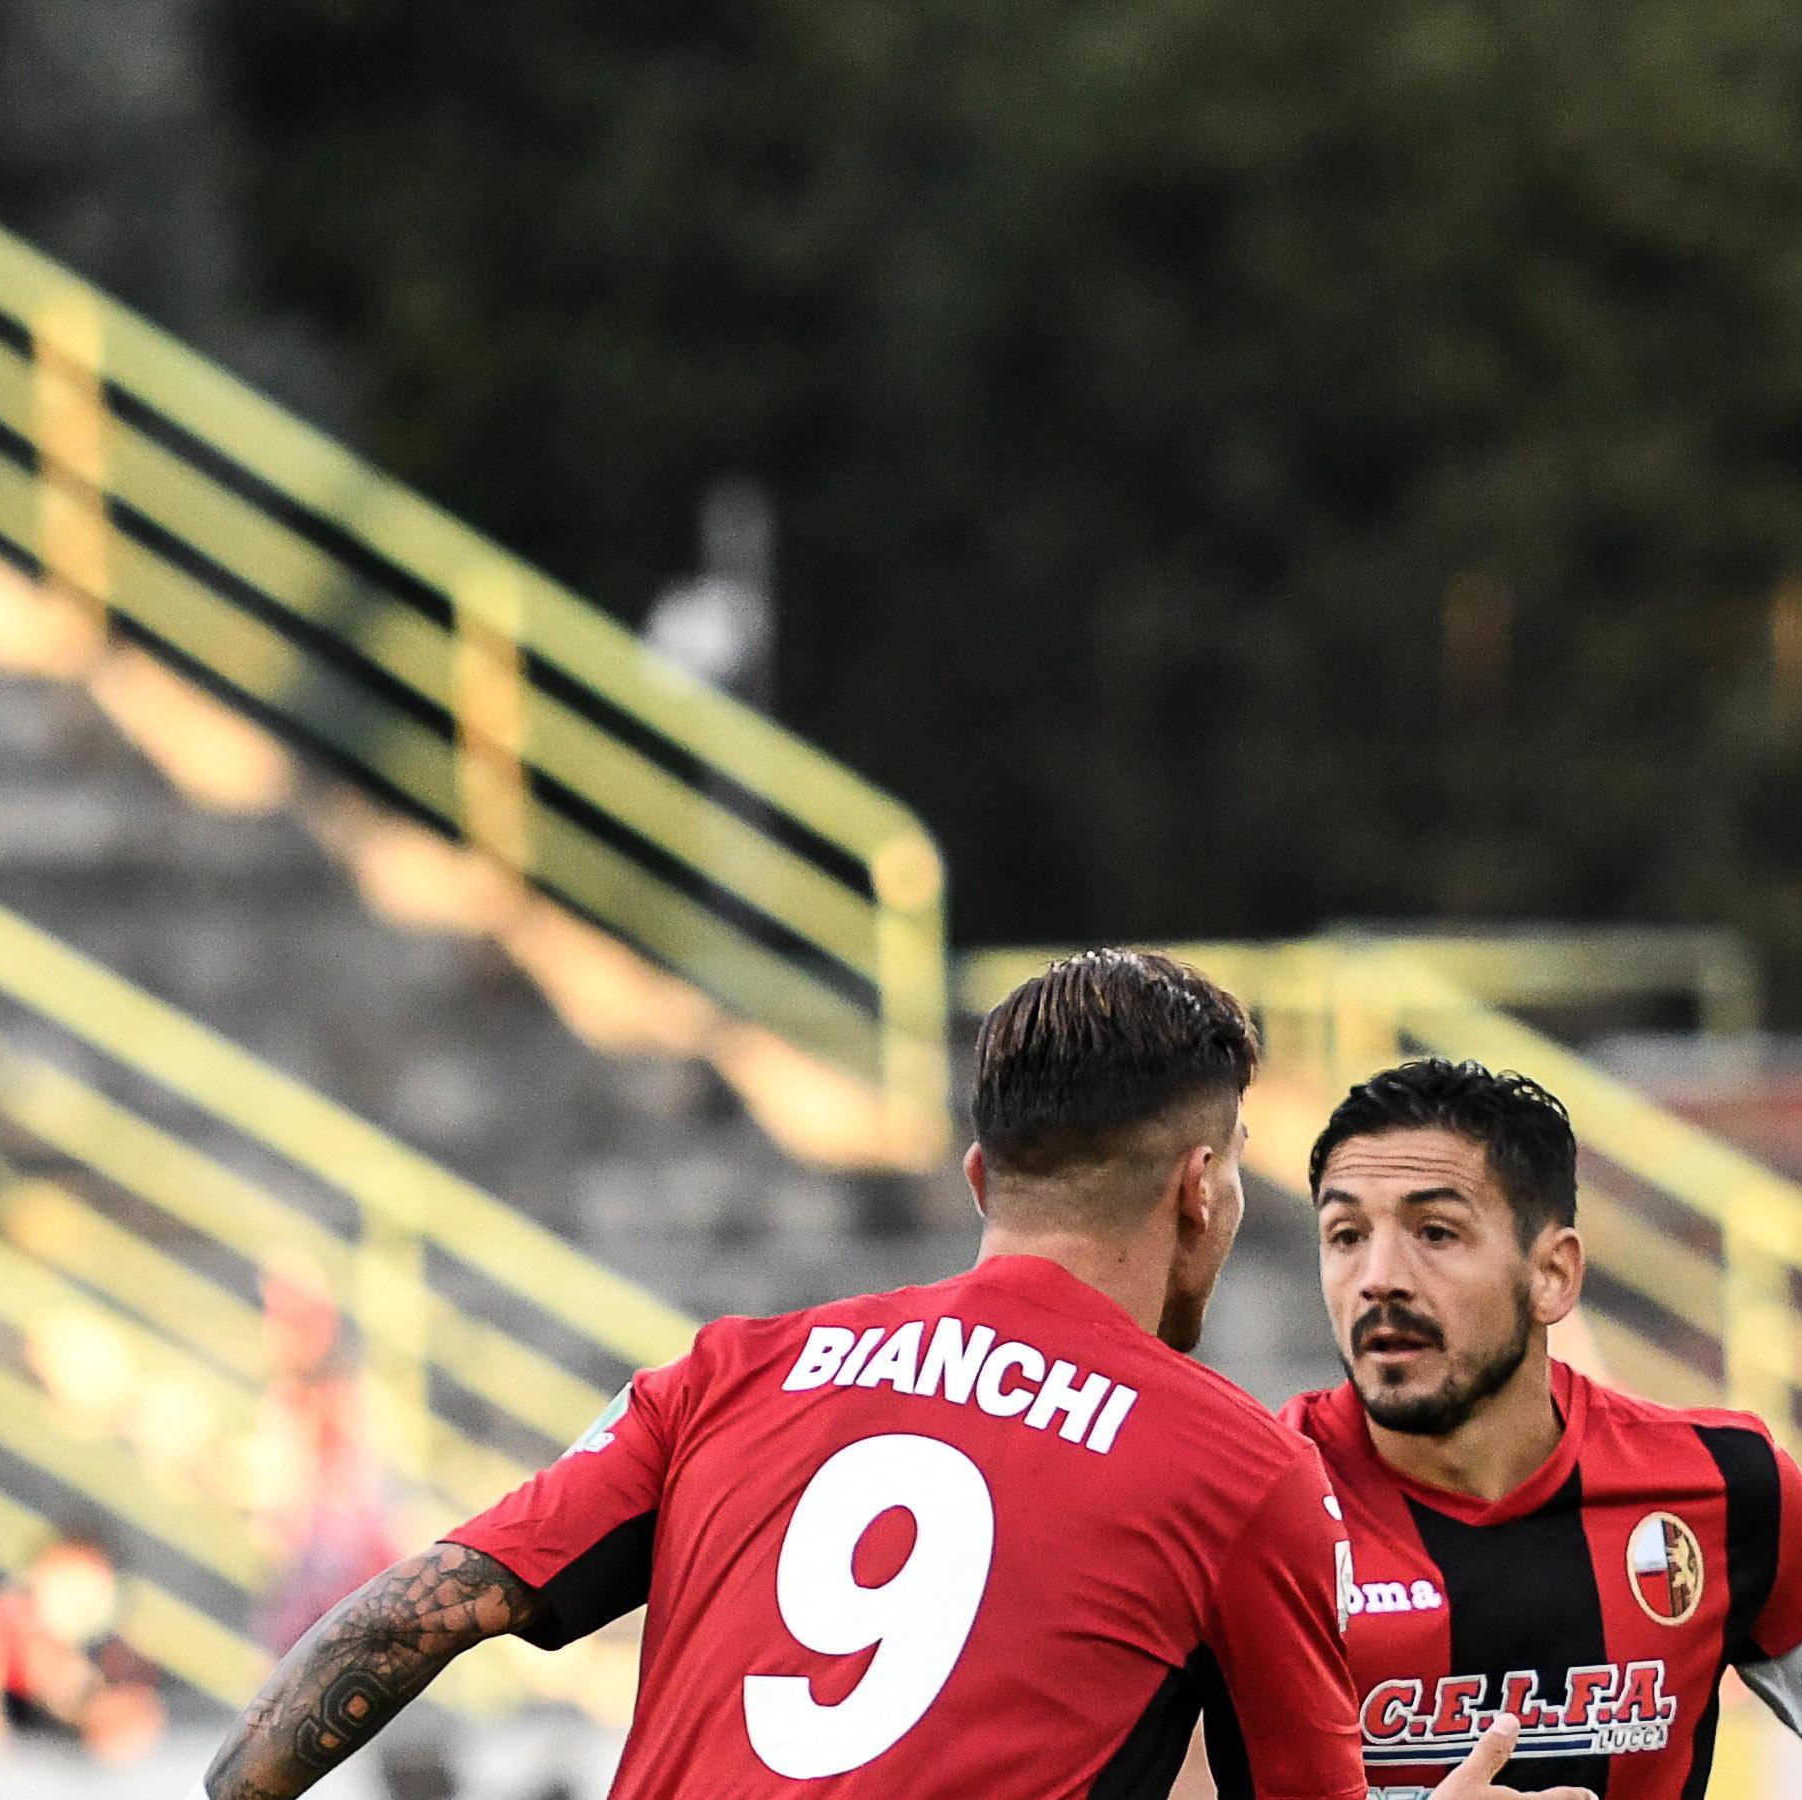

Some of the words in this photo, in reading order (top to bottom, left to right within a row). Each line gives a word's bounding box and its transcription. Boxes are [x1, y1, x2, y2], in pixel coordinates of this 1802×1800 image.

[782, 1317, 1138, 1455] BIANCHI
[744, 1433, 994, 1780] 9
[1348, 1580, 1443, 1615] oma
[1361, 1660, 1677, 1743] C.E.L.F.A.
